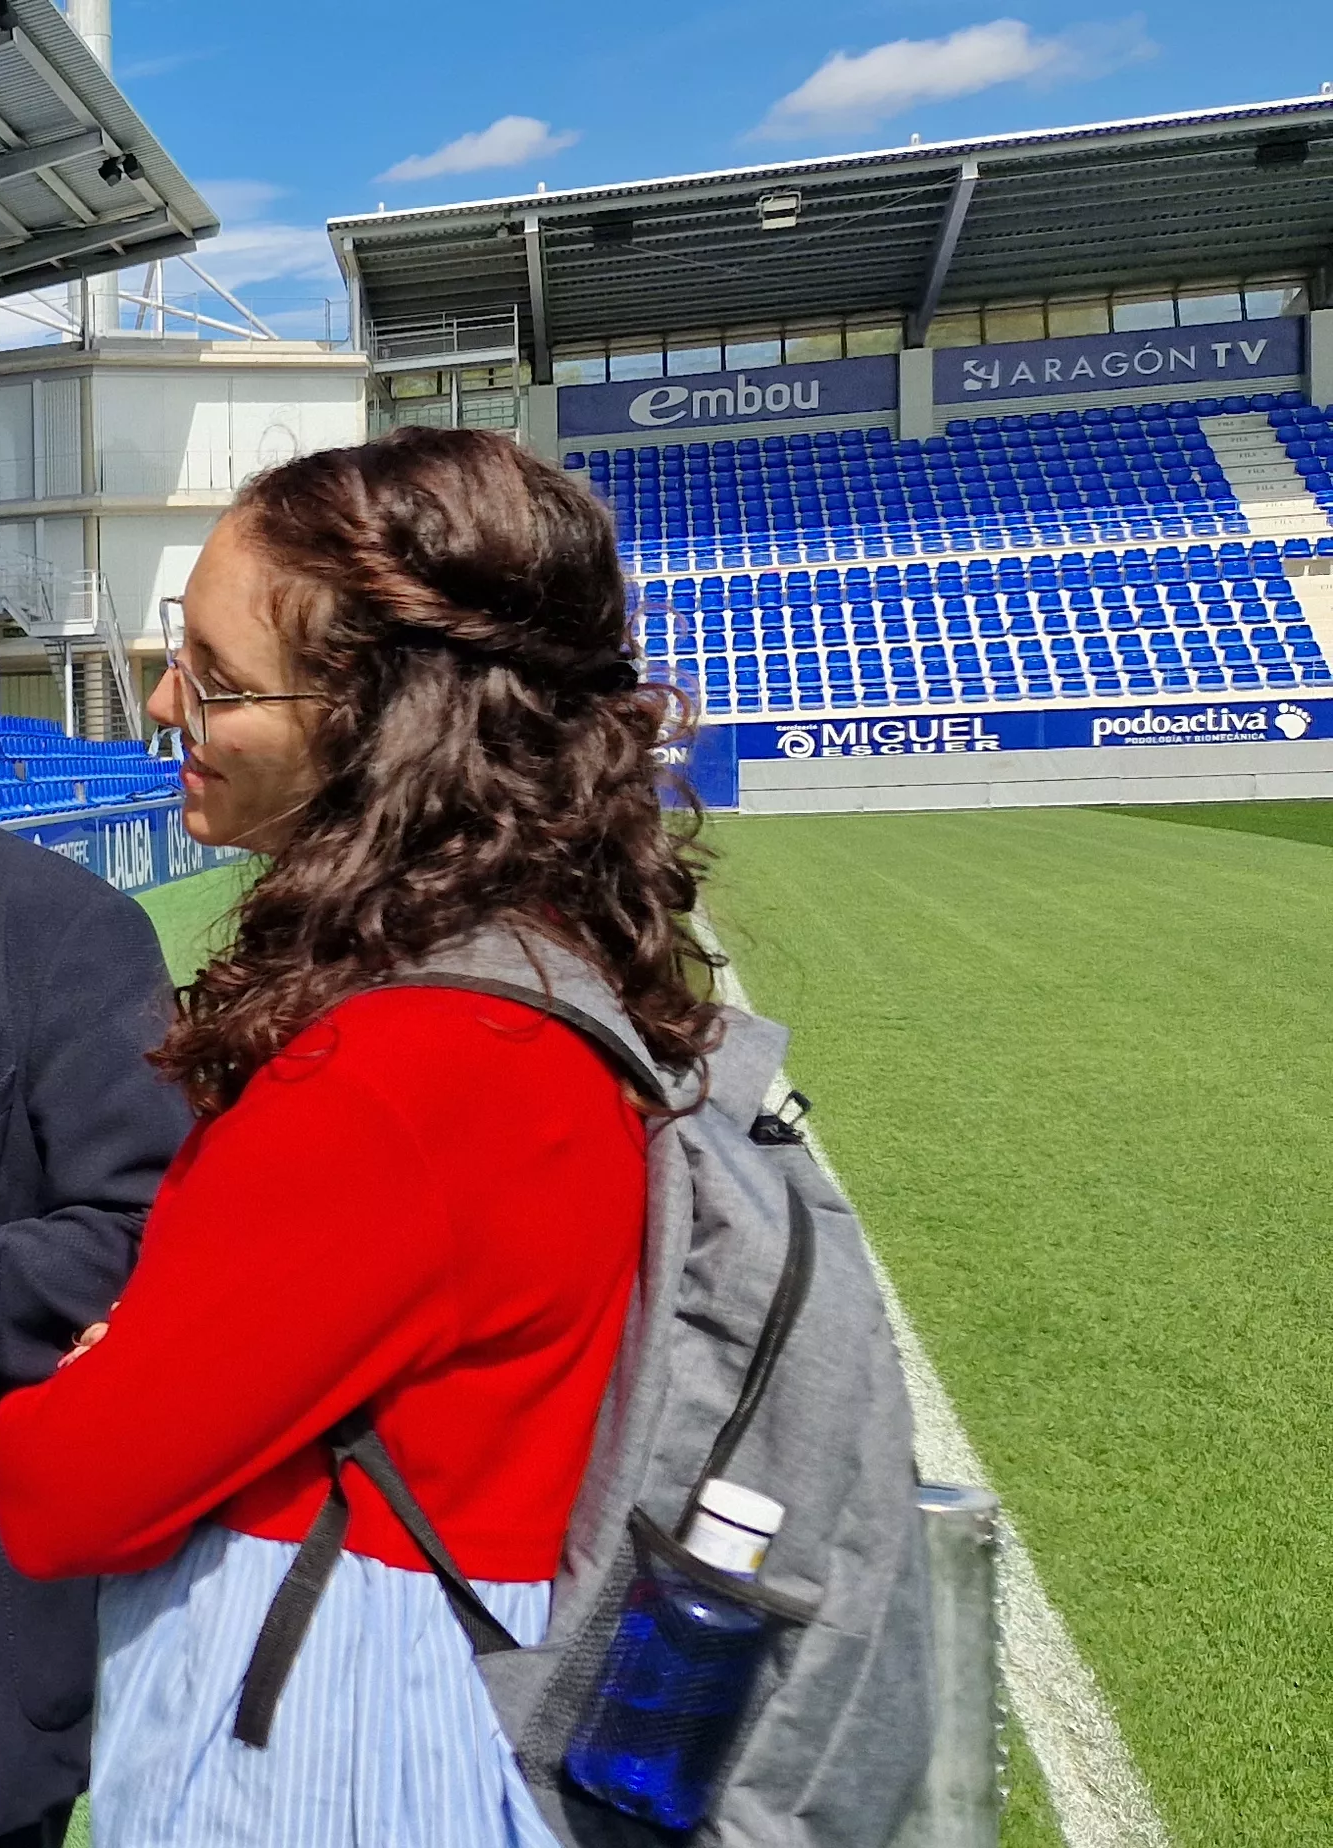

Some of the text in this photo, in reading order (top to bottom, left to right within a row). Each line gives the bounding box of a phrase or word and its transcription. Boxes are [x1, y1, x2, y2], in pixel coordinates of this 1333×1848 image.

[1008, 339, 1268, 387] ARAGÓN TV
[629, 374, 820, 427] embou
[822, 717, 1000, 746] MIGUEL
[1092, 706, 1268, 747] podoactiva
[1185, 735, 1193, 743] Y
[822, 740, 1002, 758] ESCUER
[105, 818, 153, 890] LALIGA
